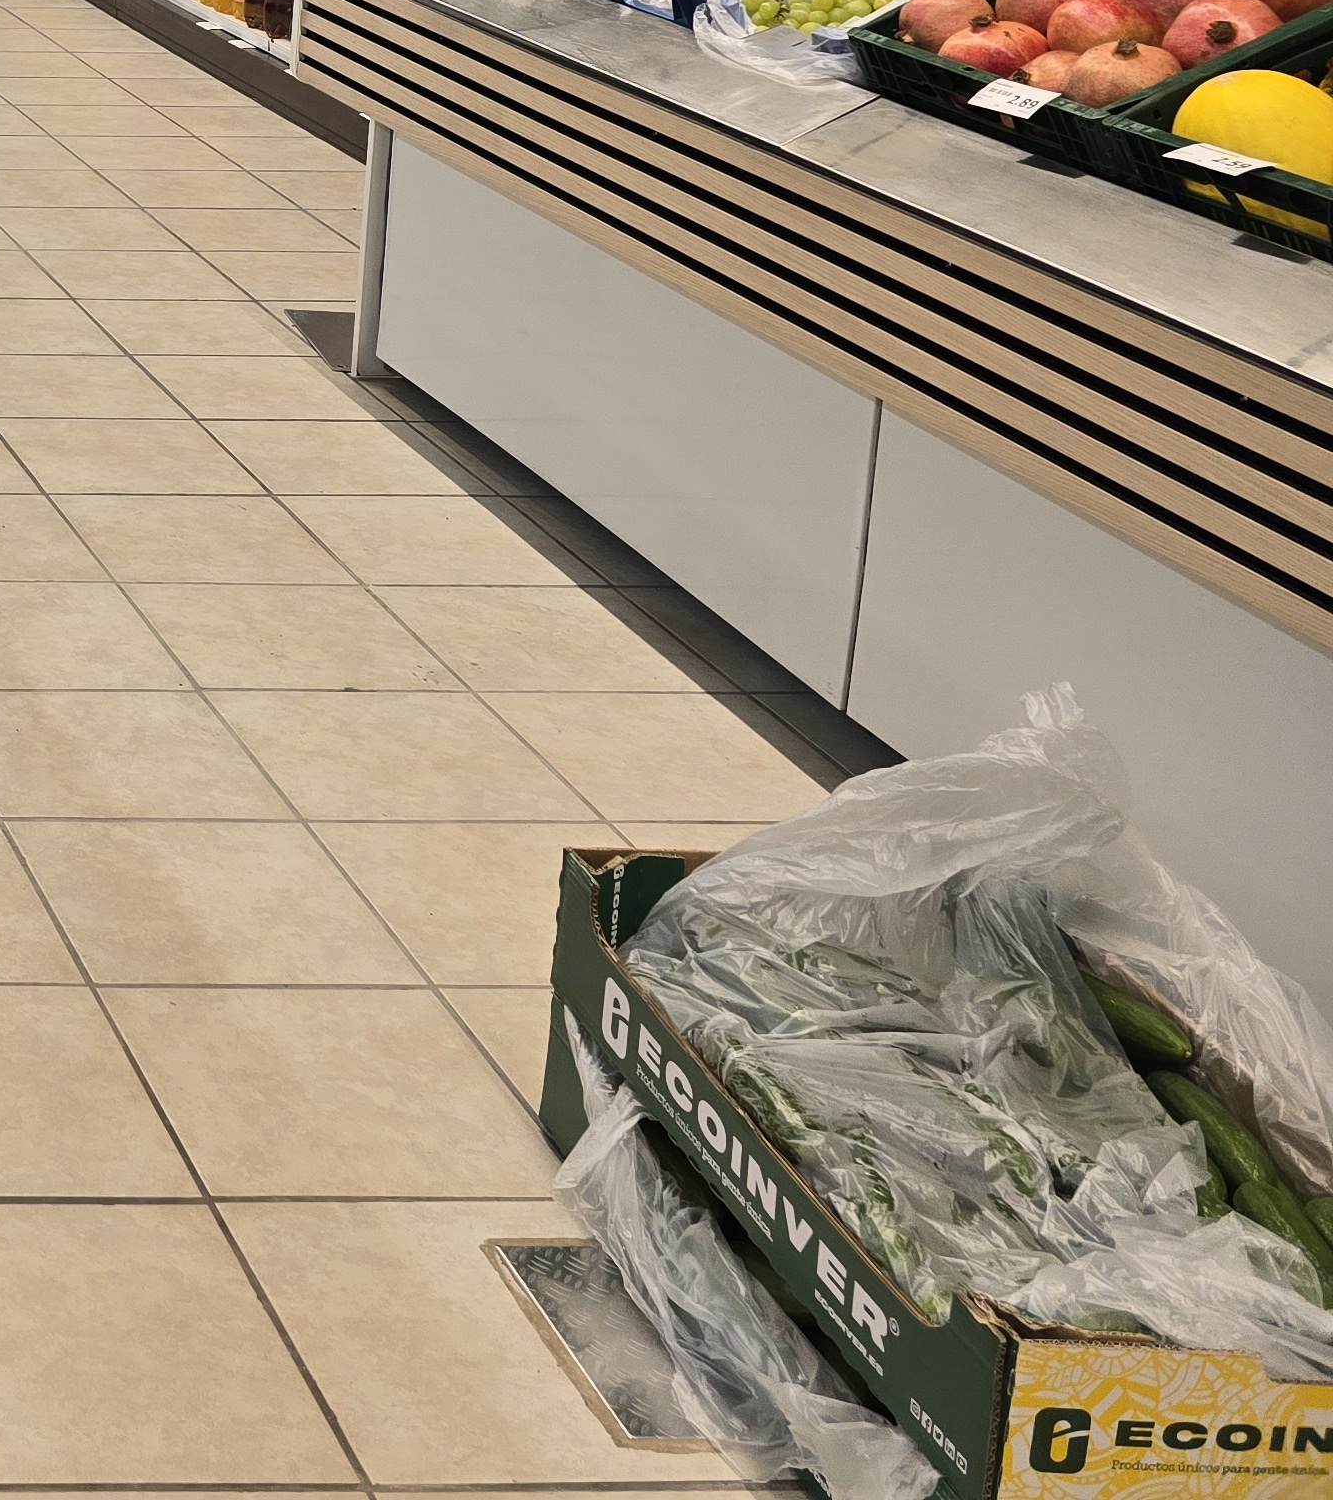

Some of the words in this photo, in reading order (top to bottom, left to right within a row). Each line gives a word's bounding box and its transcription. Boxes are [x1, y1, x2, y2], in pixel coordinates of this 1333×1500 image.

[1007, 94, 1040, 110] 2.89
[636, 1062, 675, 1114] Productos
[638, 1023, 889, 1352] ECOINVER
[1115, 1420, 1333, 1453] ECOIN
[1111, 1459, 1175, 1473] Productos
[1178, 1459, 1220, 1474] únicos
[1221, 1465, 1251, 1477] para
